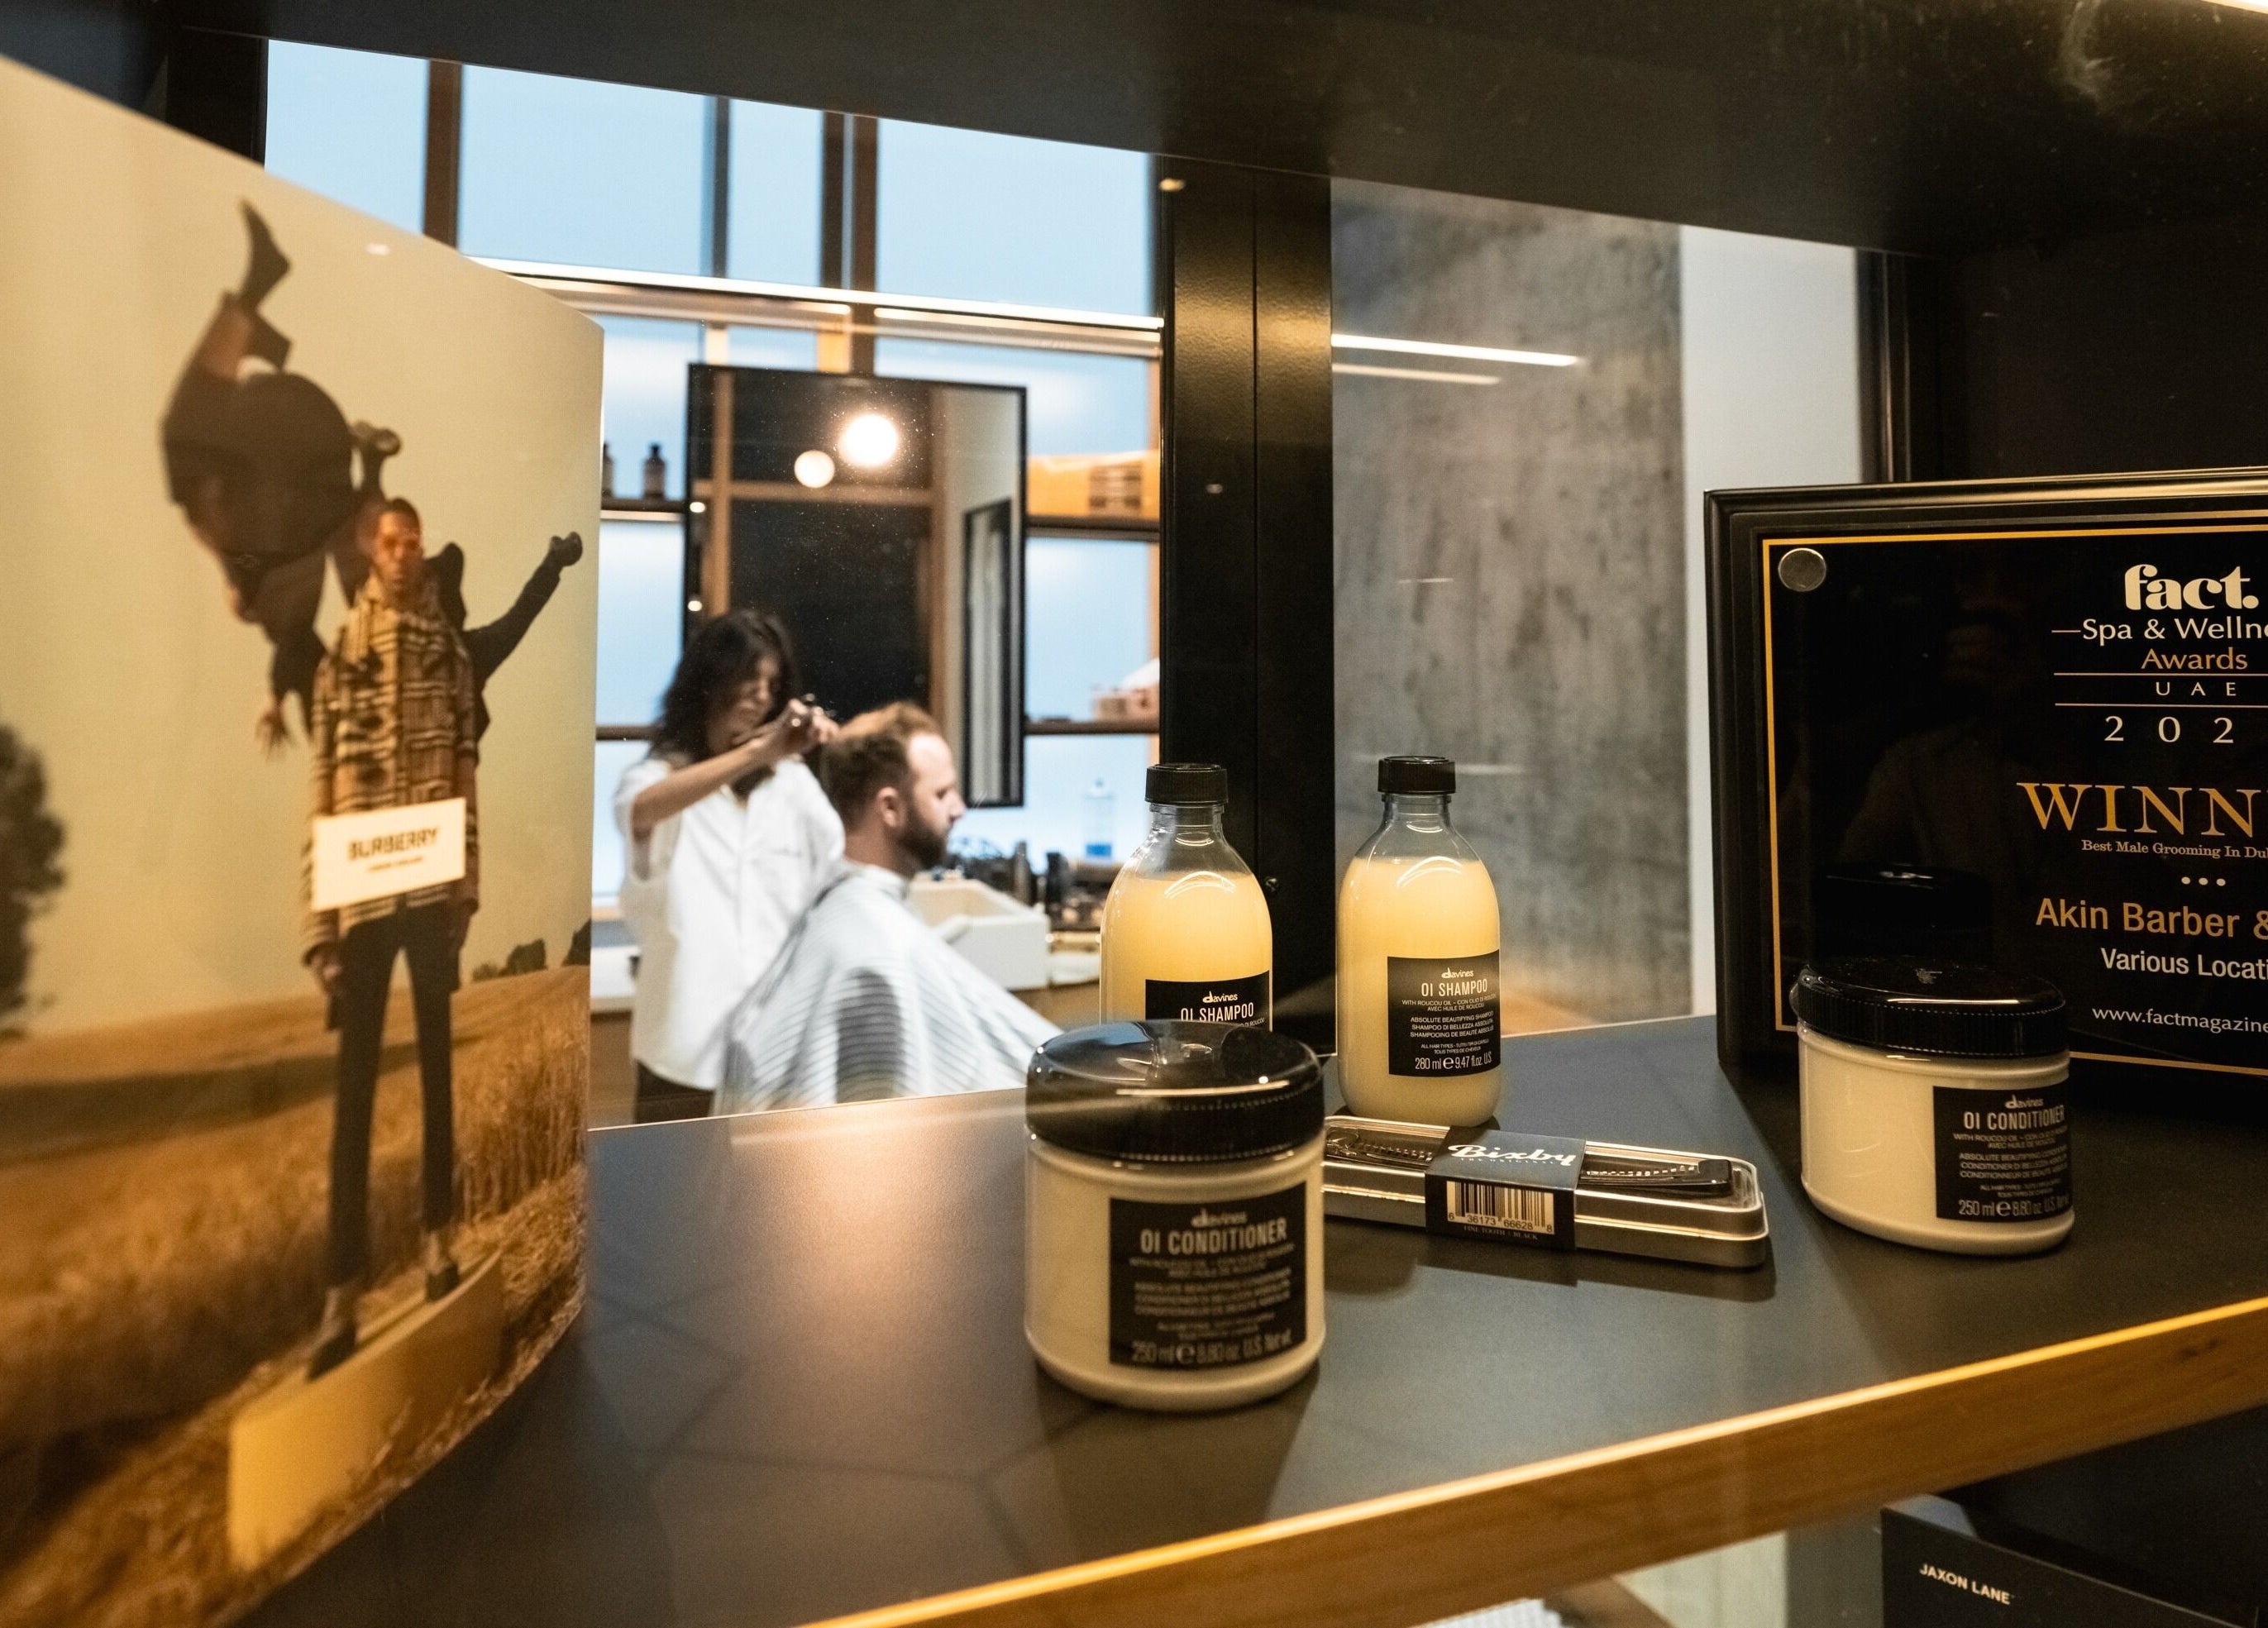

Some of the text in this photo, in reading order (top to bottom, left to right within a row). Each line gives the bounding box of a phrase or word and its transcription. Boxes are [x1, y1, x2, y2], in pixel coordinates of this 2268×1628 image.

[2125, 564, 2259, 610] fact.
[2083, 618, 2132, 646] Spa
[2144, 619, 2165, 640] &
[2141, 647, 2248, 670] Awards
[2017, 782, 2268, 838] WINN
[2081, 839, 2268, 859] Best Male Grooming In Du
[2036, 898, 2108, 930] Akin
[2123, 902, 2240, 938] Barber
[1442, 967, 1474, 979] davines
[2101, 948, 2189, 975] Various
[1202, 991, 1238, 1003] davines
[1421, 978, 1487, 997] OI SHAMPOO
[1200, 1002, 1253, 1022] SHAMPOO
[2092, 1008, 2268, 1034] www.factmagazine
[1415, 1057, 1430, 1070] 280
[1432, 1057, 1442, 1070] ml
[1455, 1055, 1470, 1069] 9.47
[1964, 1105, 2065, 1130] OI CONDITIONER
[1448, 1144, 1576, 1167] Bixby
[1959, 1200, 1980, 1216] 250
[1467, 1215, 1496, 1225] 36173
[1504, 1220, 1533, 1230] 66628
[1546, 1225, 1552, 1233] 8
[1168, 1218, 1287, 1254] CONDITIONER
[1919, 1563, 2010, 1605] JAXON LANE
